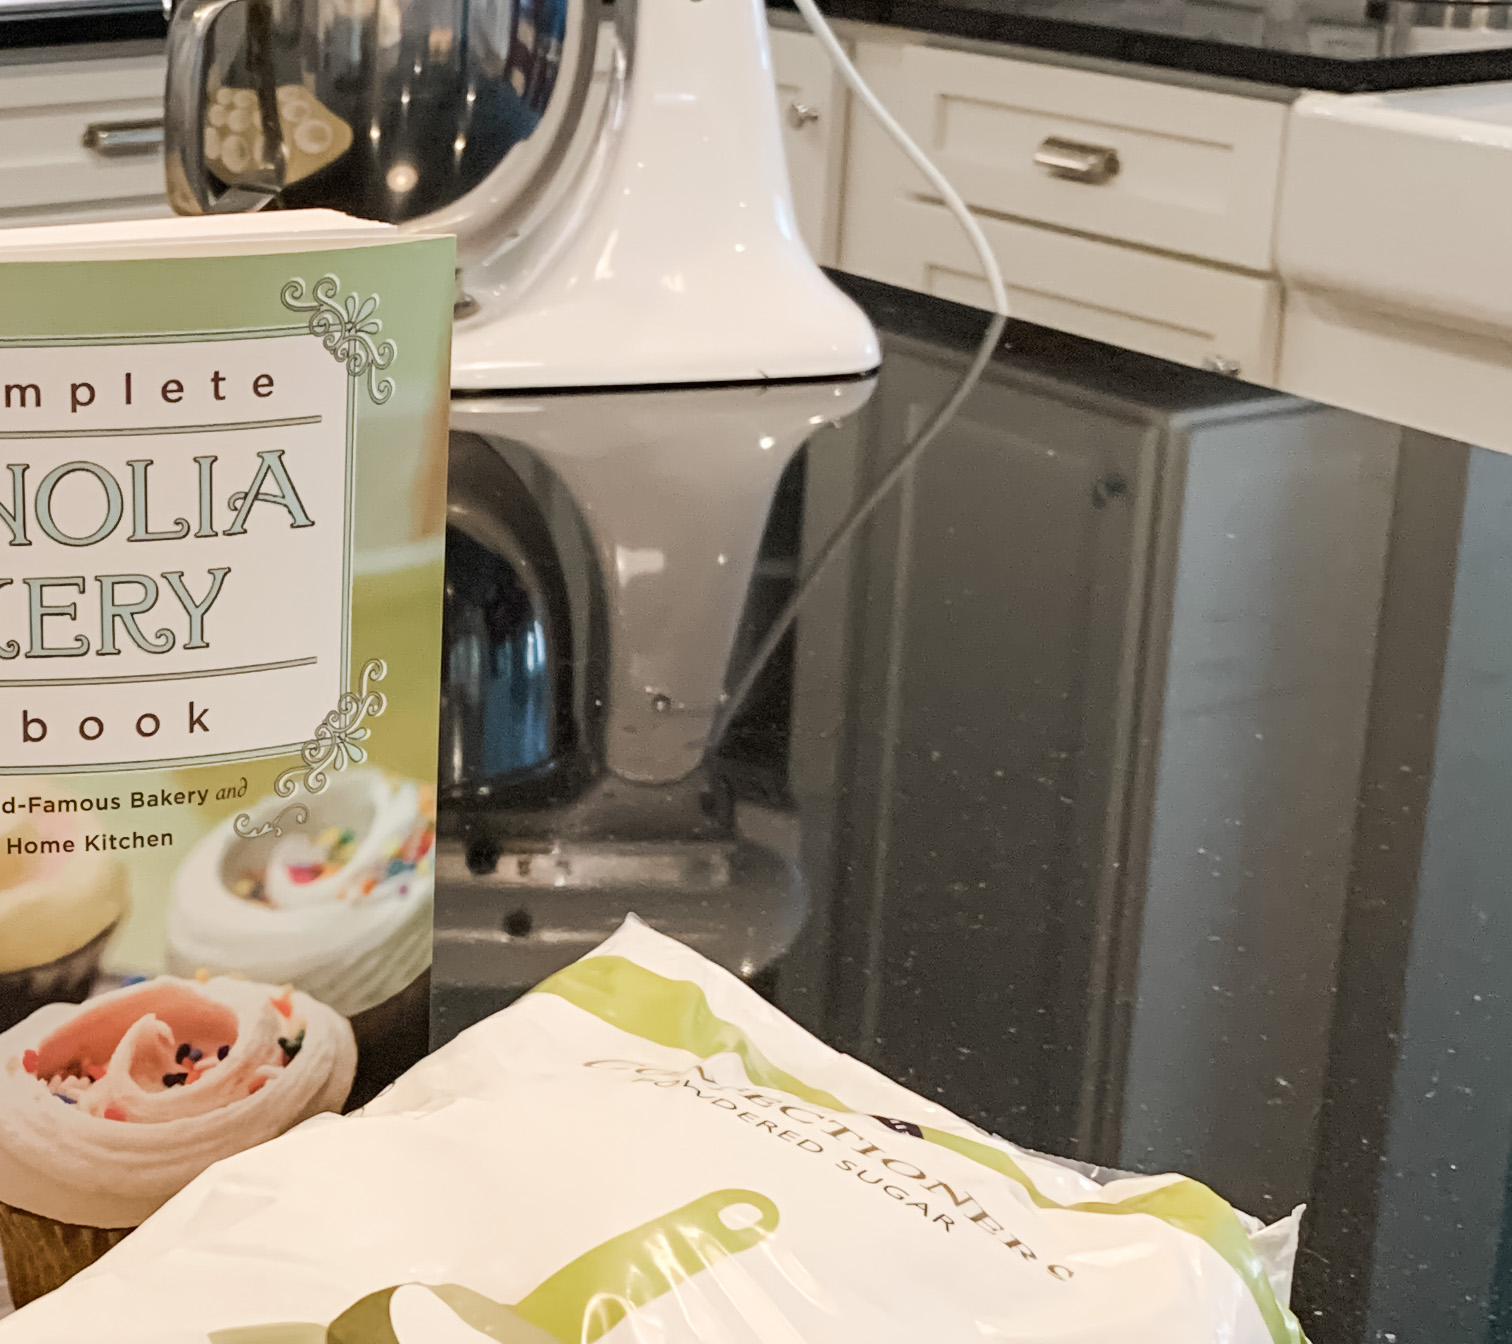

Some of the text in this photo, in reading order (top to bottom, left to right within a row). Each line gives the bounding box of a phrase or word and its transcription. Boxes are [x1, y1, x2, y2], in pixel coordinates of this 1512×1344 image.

[130, 787, 210, 810] Bakery
[215, 777, 249, 802] and
[6, 837, 76, 856] Home
[85, 830, 174, 853] Kitchen
[835, 1157, 955, 1233] SUGAR
